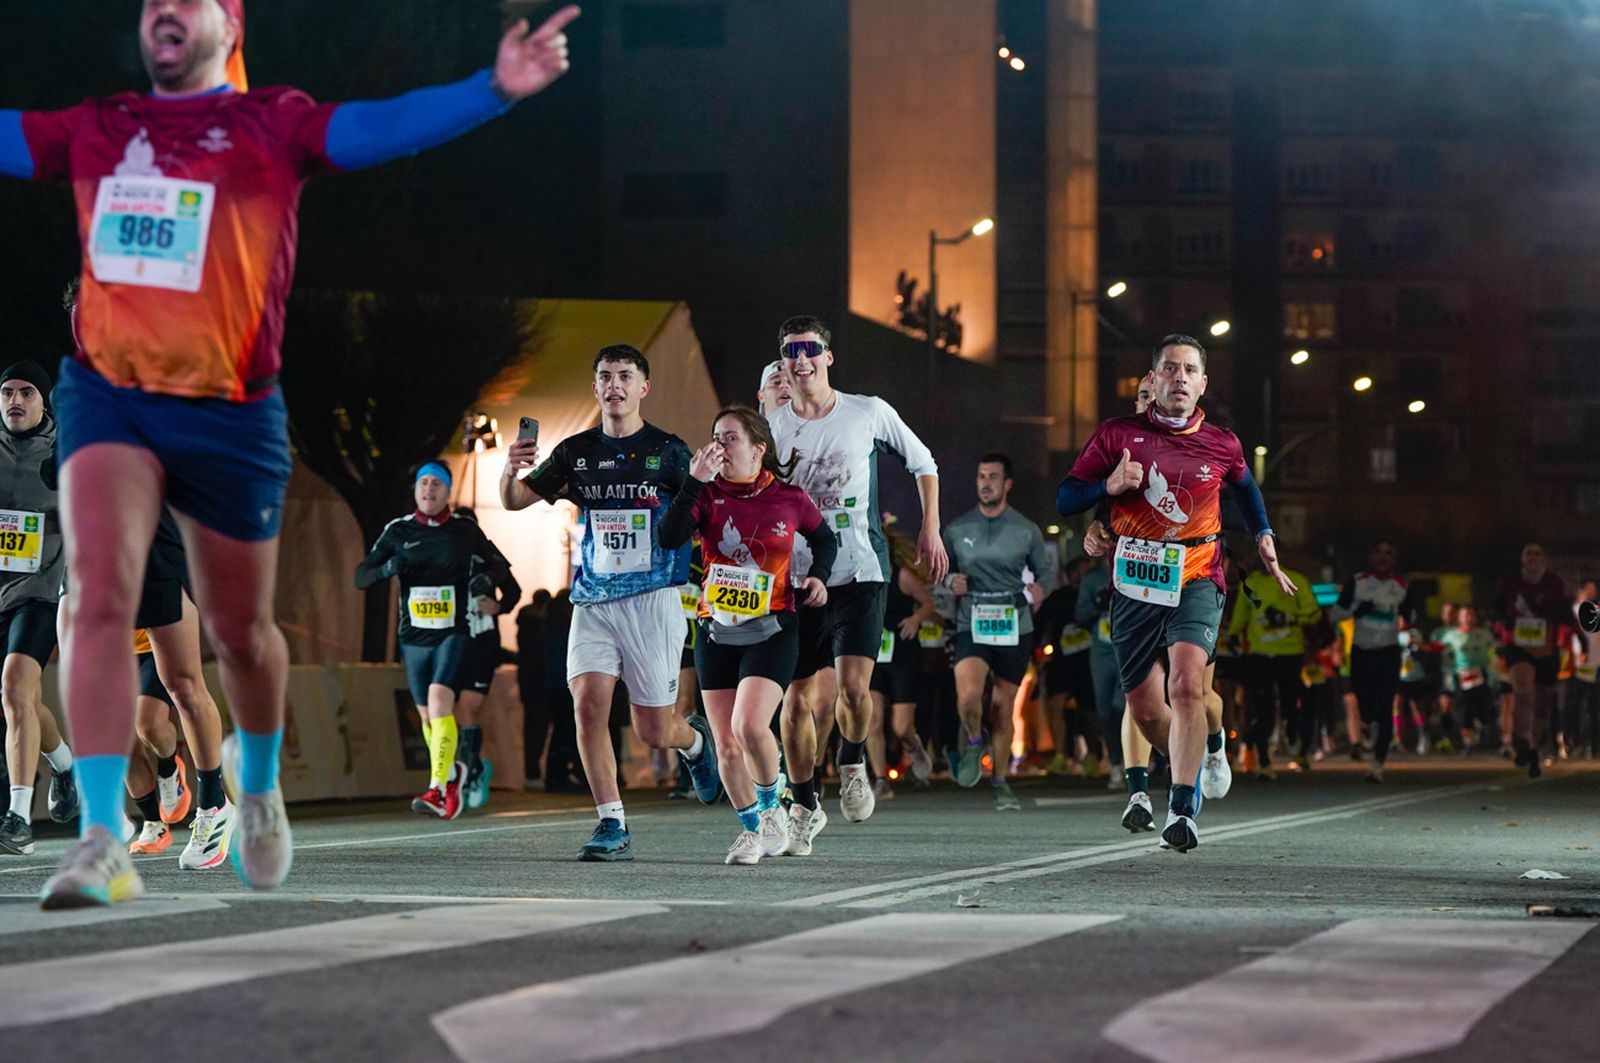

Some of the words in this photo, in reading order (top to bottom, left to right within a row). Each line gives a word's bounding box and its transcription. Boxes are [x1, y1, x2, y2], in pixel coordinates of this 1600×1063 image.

[118, 214, 176, 250] 986
[1158, 496, 1175, 513] 43
[602, 532, 637, 550] 4571
[1122, 551, 1136, 559] SAN
[1126, 560, 1171, 584] 8003
[715, 579, 730, 587] SAN
[715, 587, 760, 610] 2330
[415, 602, 449, 614] 13794
[977, 619, 1013, 632] 13894
